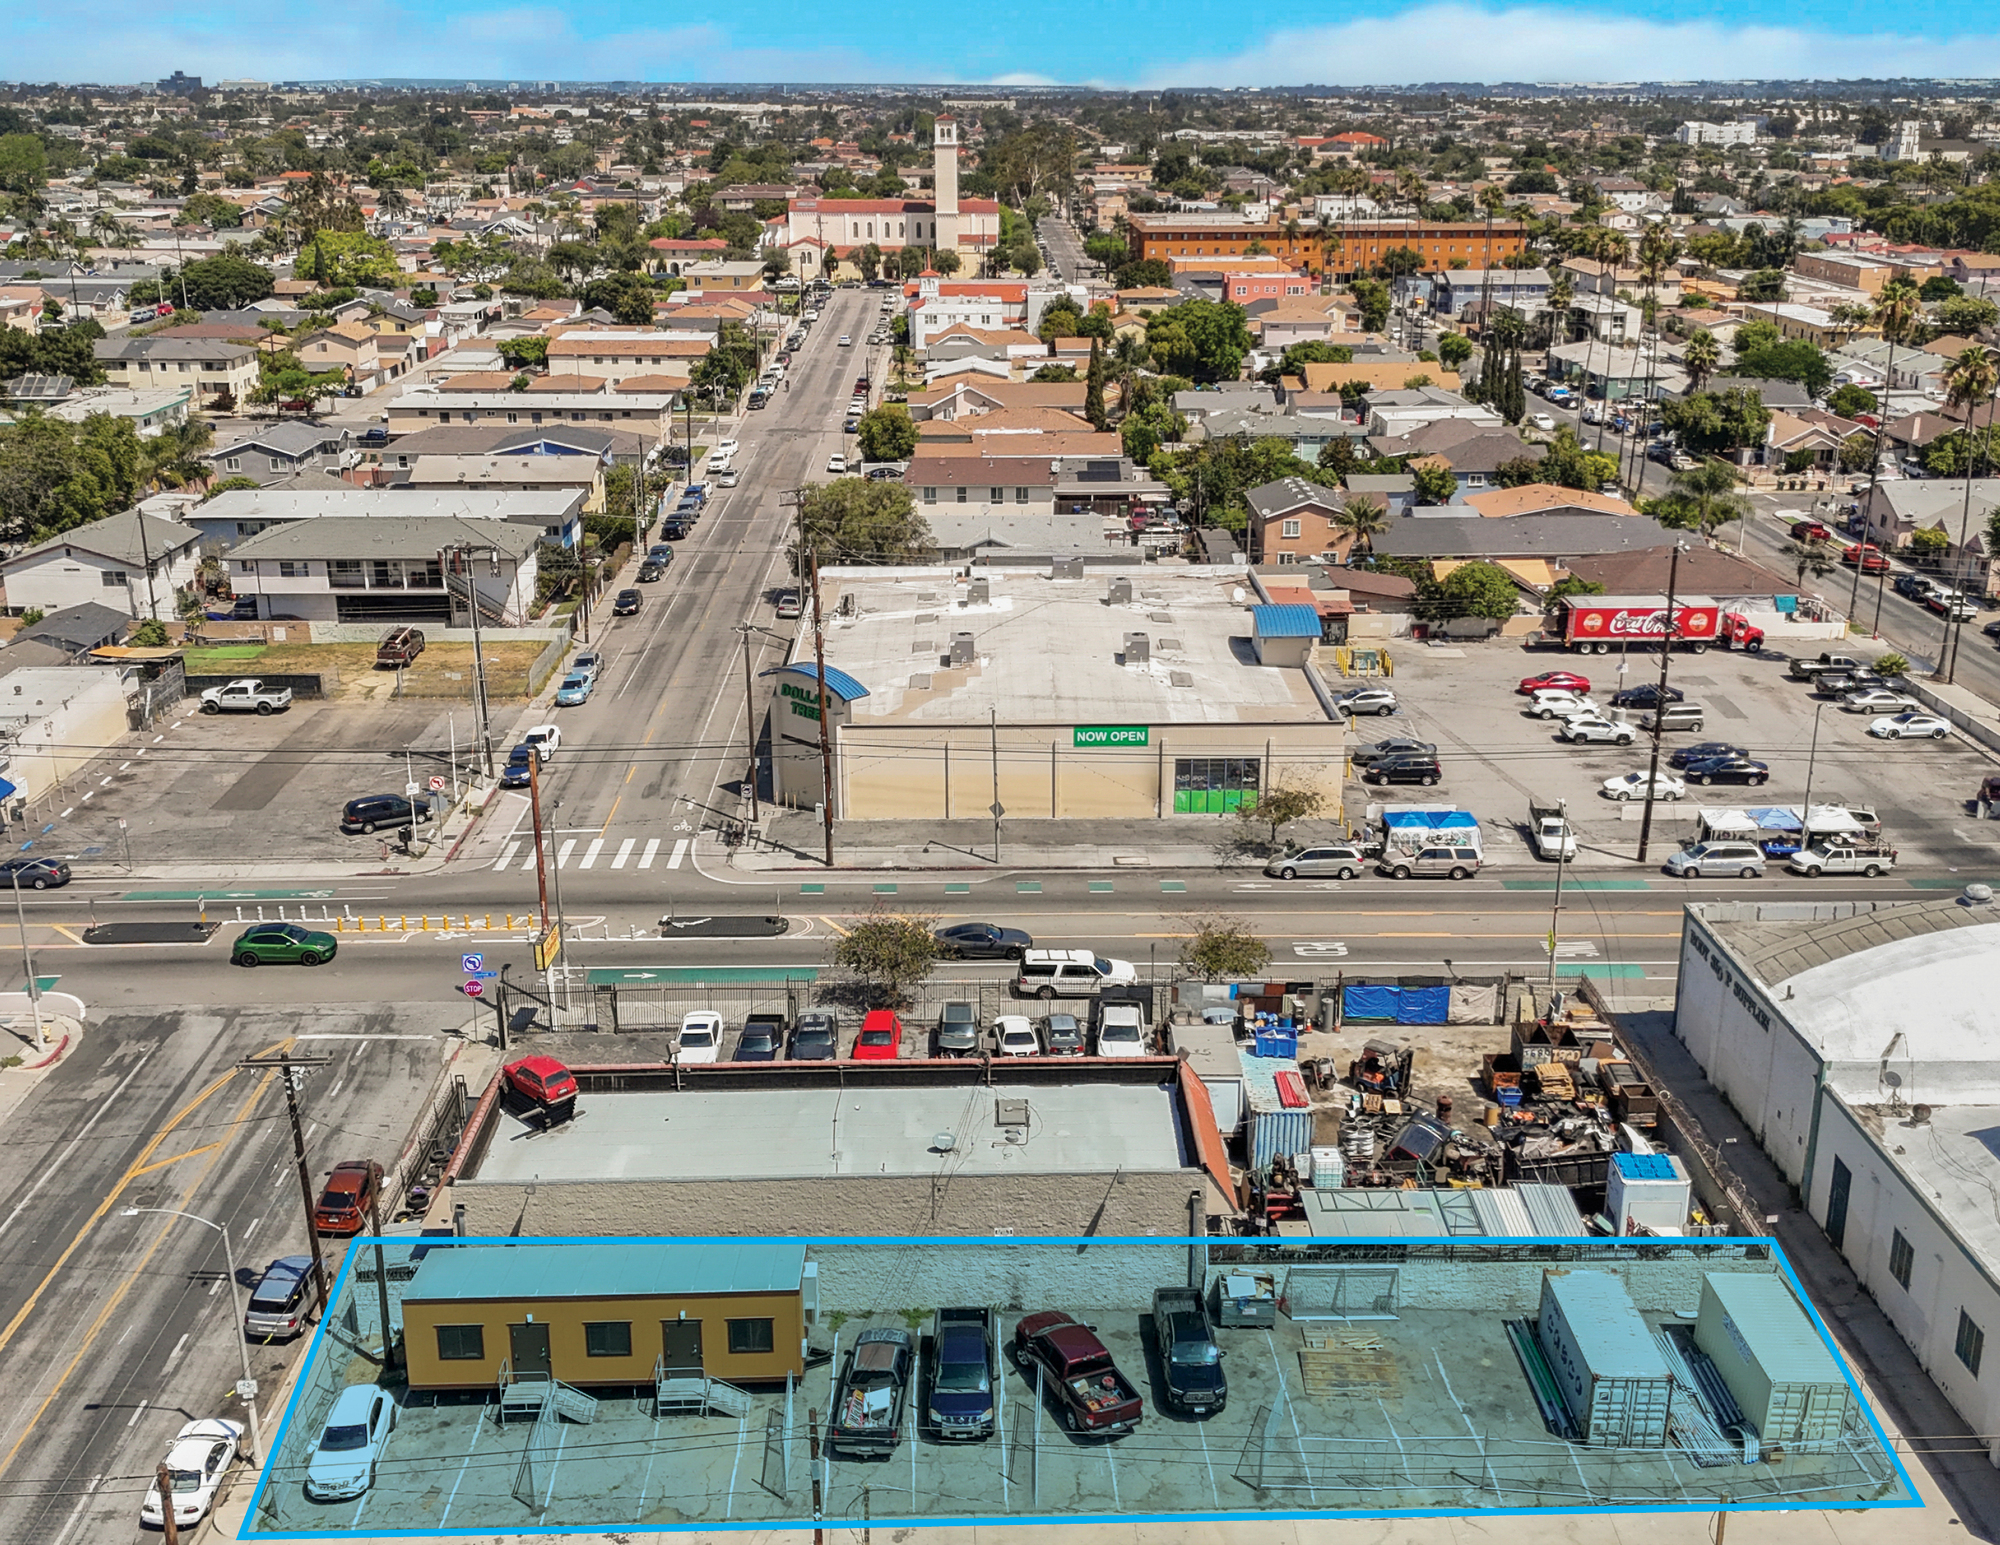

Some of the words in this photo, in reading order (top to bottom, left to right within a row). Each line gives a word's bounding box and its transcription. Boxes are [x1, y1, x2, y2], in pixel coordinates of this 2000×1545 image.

[790, 701, 820, 722] TREE
[1077, 731, 1107, 742] NOW
[1110, 731, 1146, 742] OPEN
[465, 985, 483, 993] STOP
